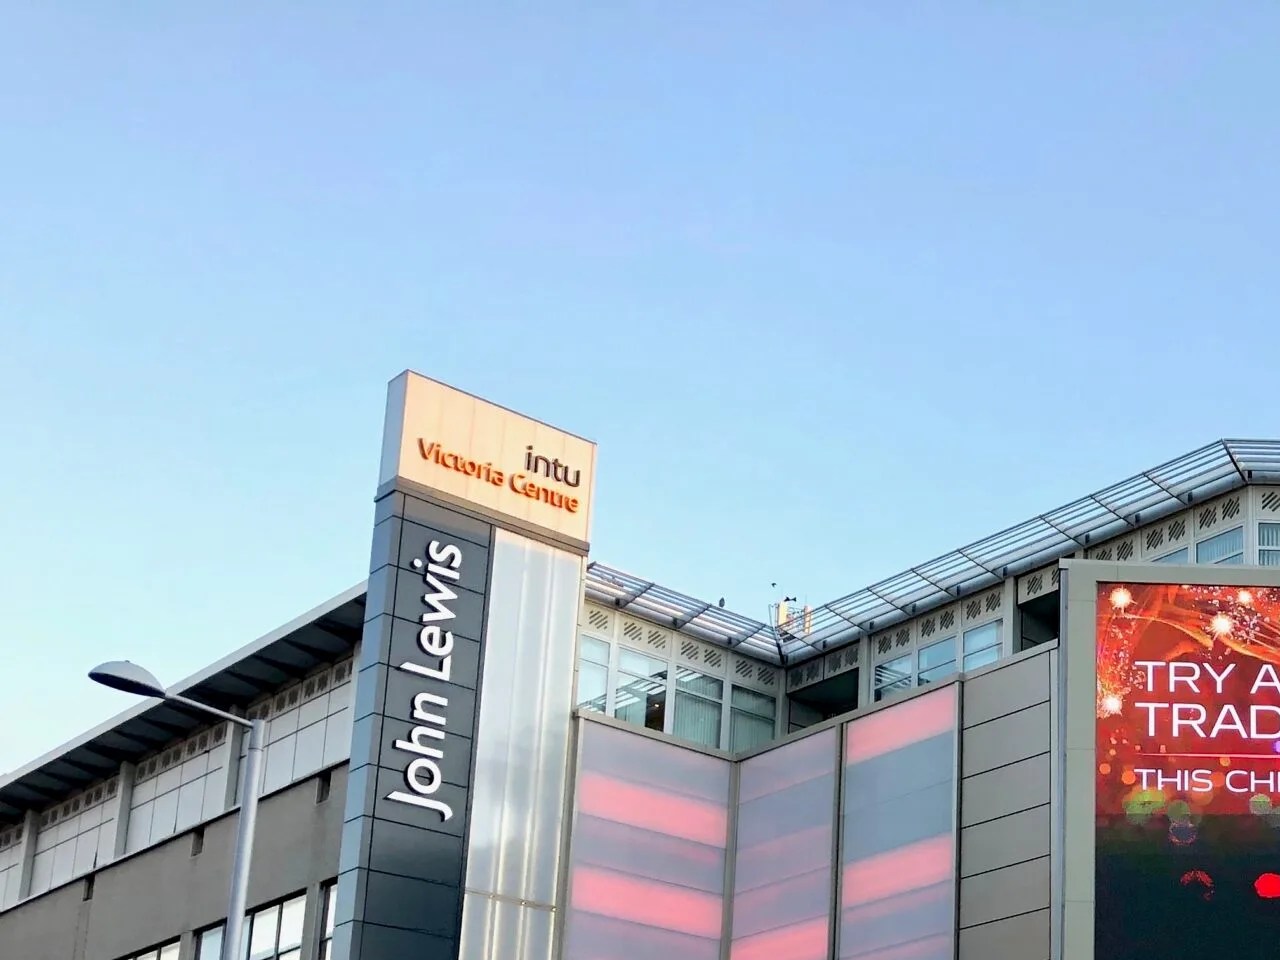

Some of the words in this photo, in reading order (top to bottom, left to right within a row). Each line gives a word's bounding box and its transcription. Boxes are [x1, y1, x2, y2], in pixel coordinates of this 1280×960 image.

[417, 437, 505, 487] Victoria
[509, 473, 580, 514] Centre
[524, 445, 580, 489] intu
[399, 539, 463, 682] Lewis
[1135, 661, 1236, 694] TRY
[386, 692, 453, 823] John
[1134, 768, 1214, 793] THIS
